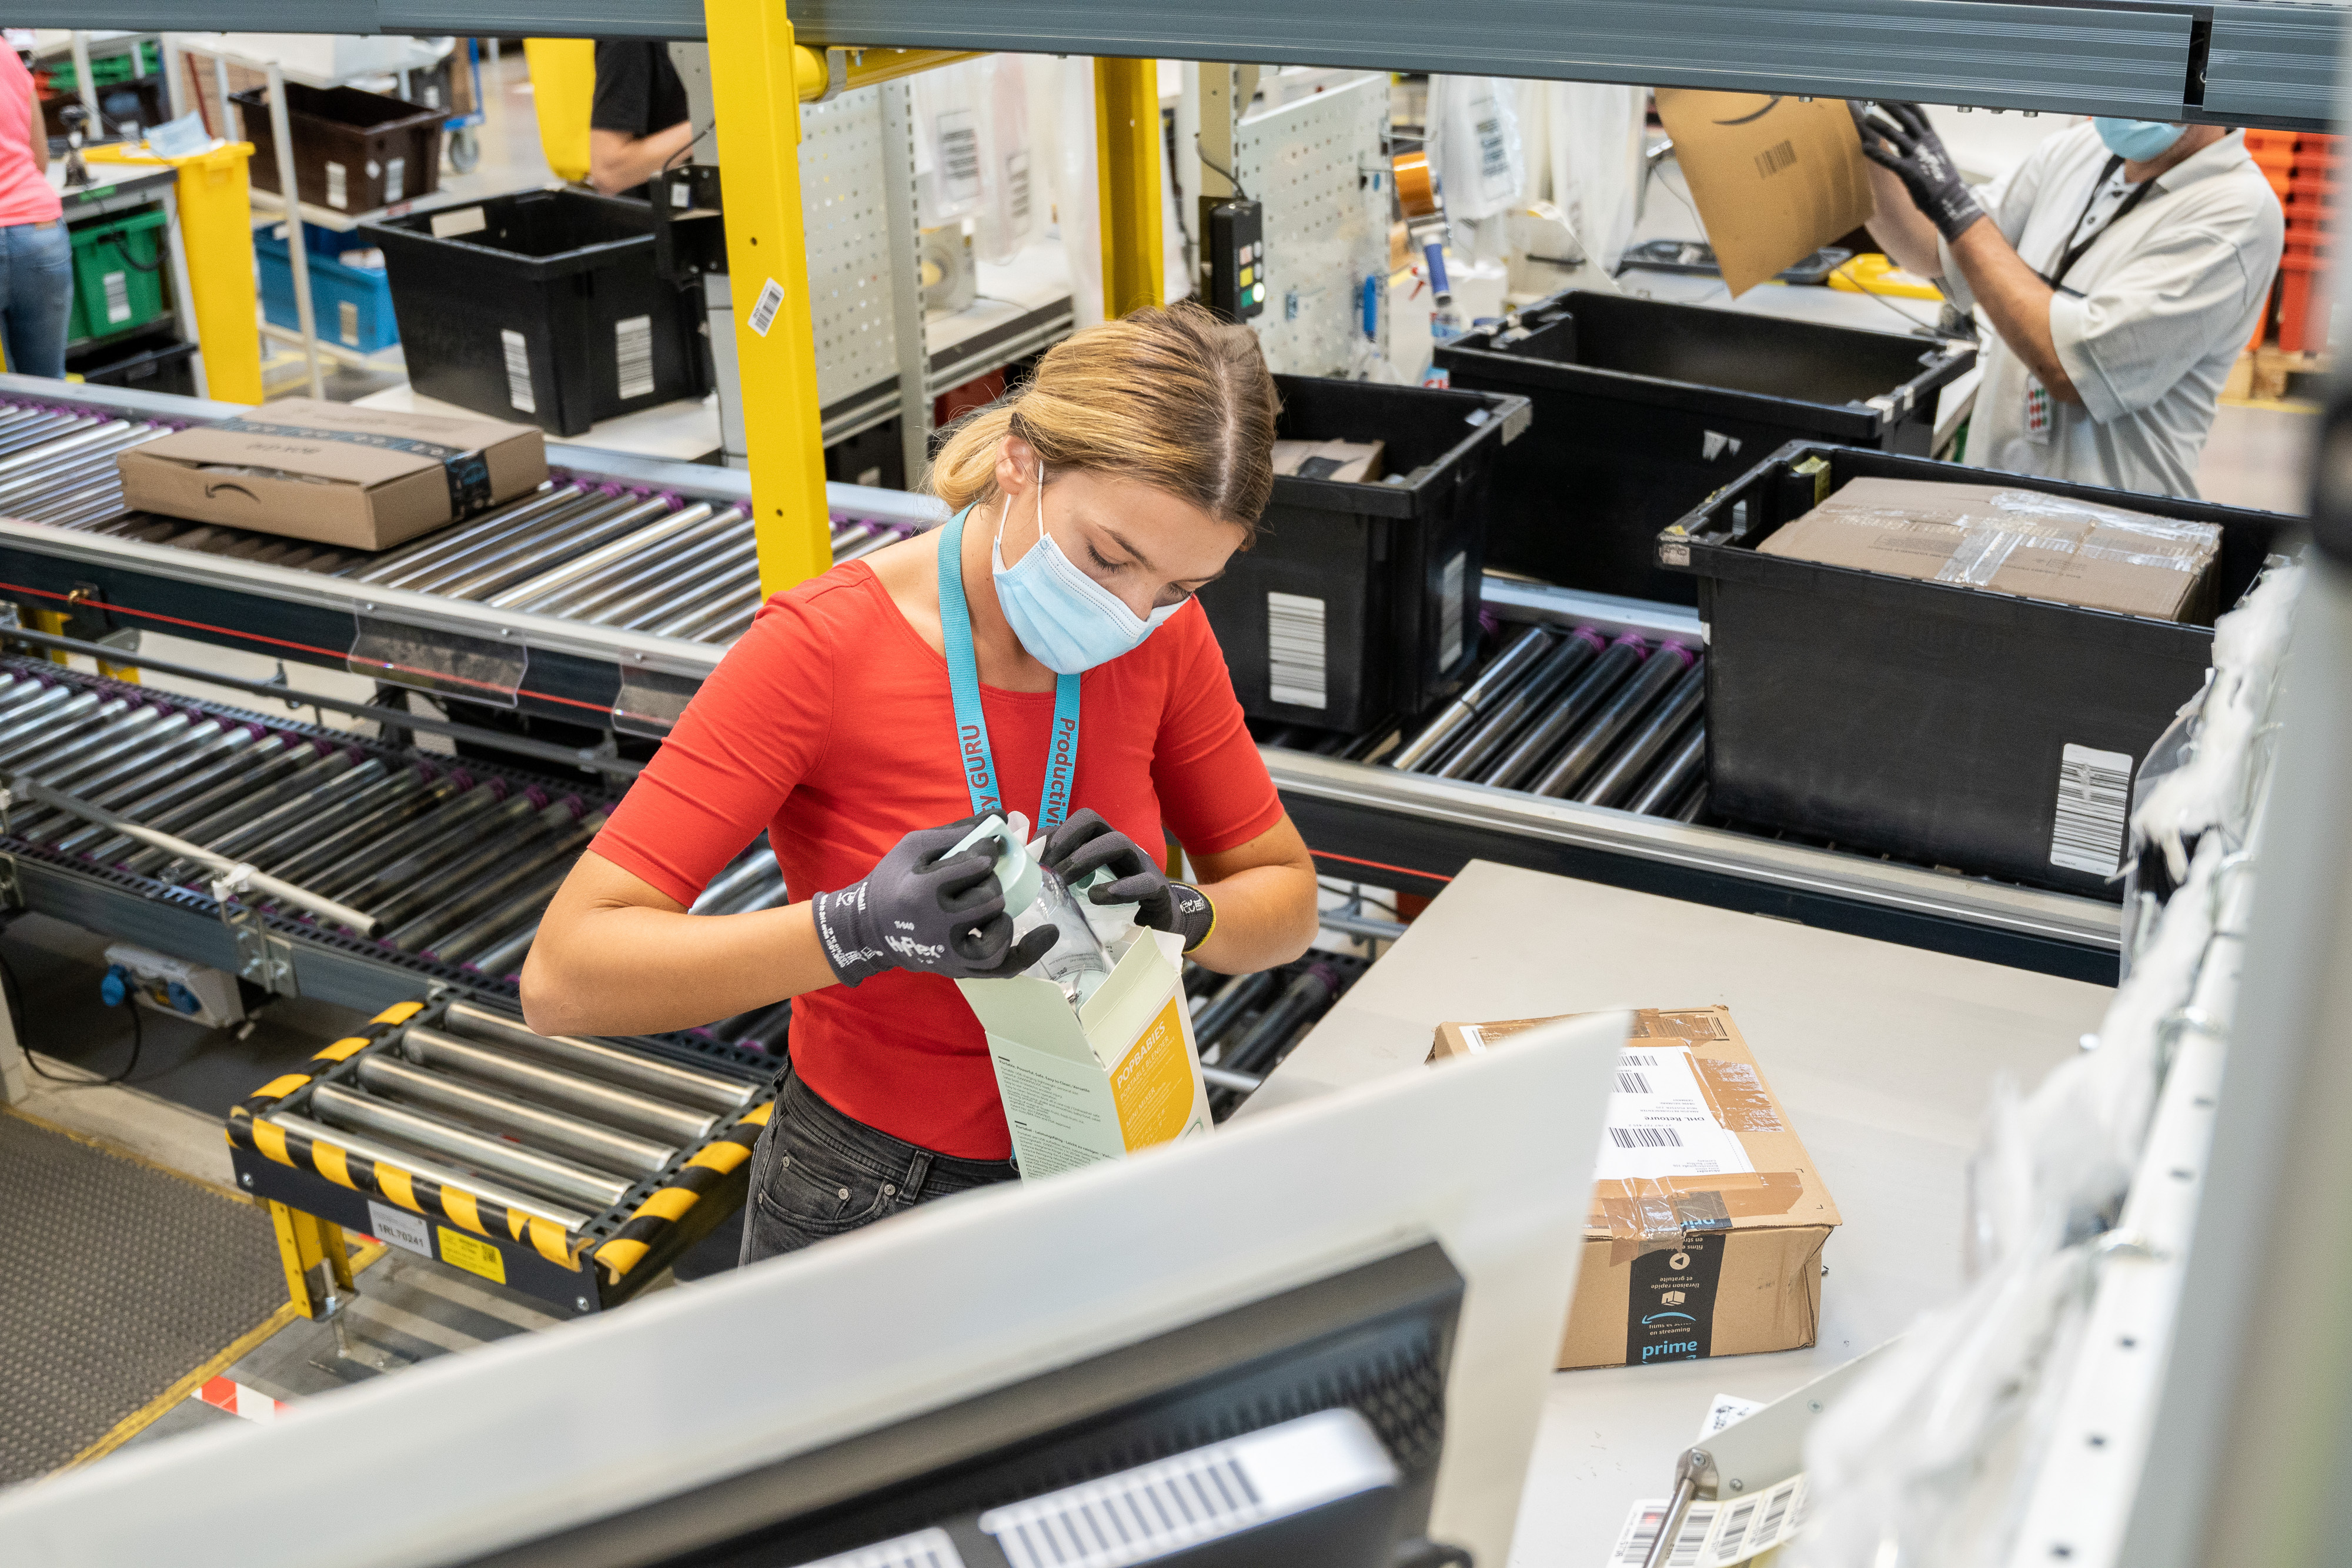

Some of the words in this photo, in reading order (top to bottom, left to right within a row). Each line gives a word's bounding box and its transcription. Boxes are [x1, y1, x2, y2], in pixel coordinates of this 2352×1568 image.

[961, 725, 989, 788] GURU
[1047, 717, 1075, 825] Productivi
[998, 1060, 1016, 1068] Portable,
[1017, 1066, 1034, 1075] Powerful,
[1073, 1084, 1090, 1093] Versatile
[1117, 1021, 1165, 1088] POPBABIES
[1120, 1064, 1145, 1101] PORTABLE
[1145, 1034, 1168, 1068] BLENDER
[1126, 1108, 1138, 1128] MINI
[1138, 1085, 1155, 1111] MIXER
[1642, 1340, 1697, 1359] prime
